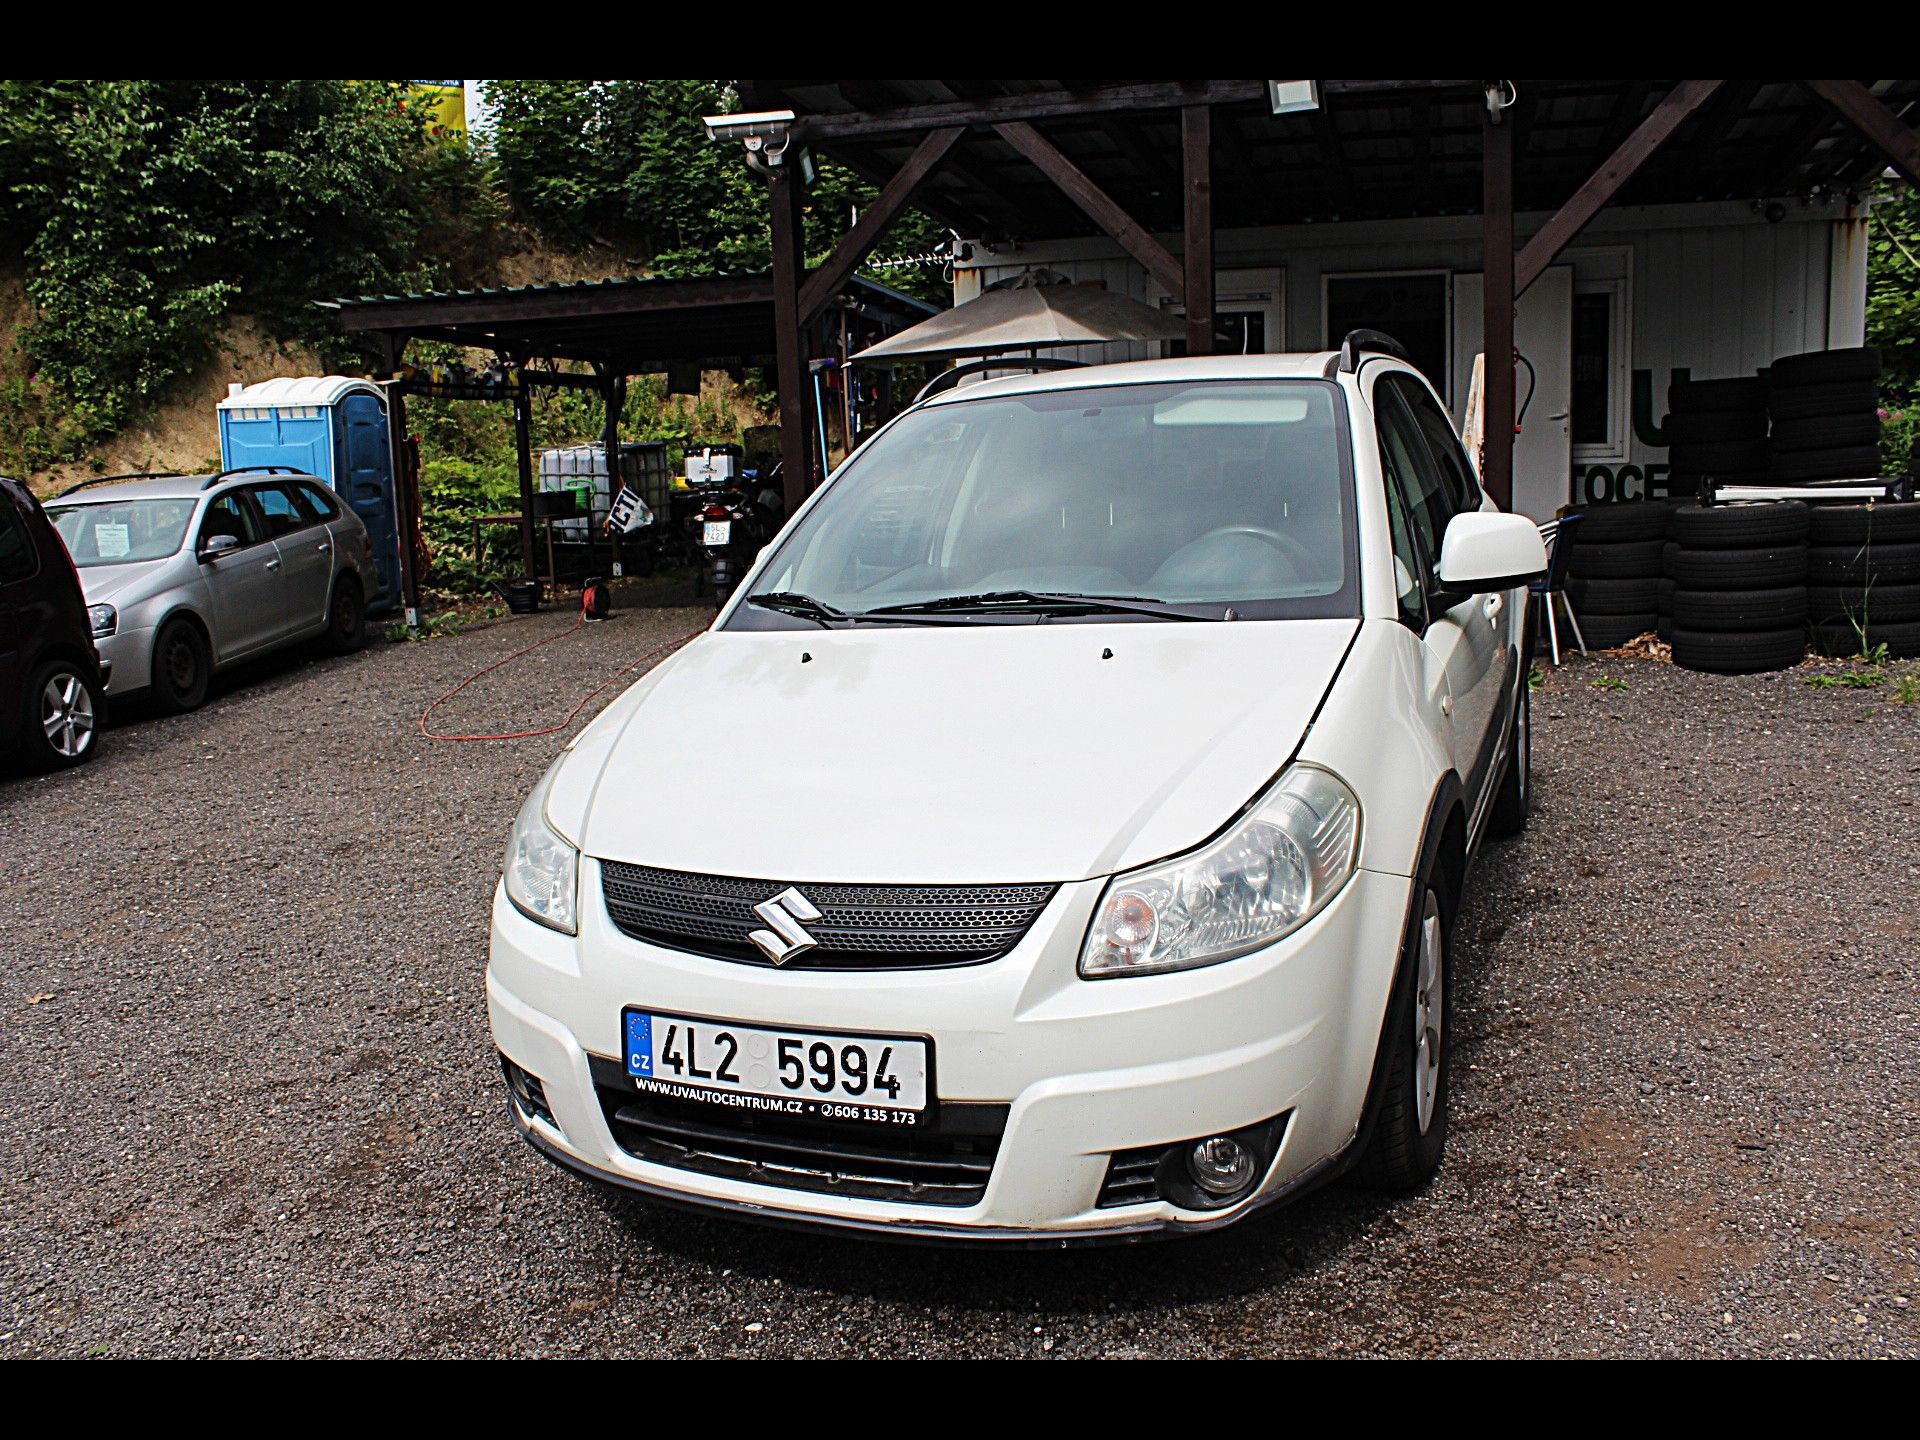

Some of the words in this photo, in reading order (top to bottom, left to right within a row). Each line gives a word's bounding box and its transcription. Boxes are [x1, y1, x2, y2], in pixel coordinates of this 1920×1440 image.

[631, 1053, 650, 1070] CZ
[661, 1024, 740, 1083] 4L2
[777, 1038, 901, 1099] 5994
[635, 1077, 803, 1114] WWW.UVAUTOCENTRUM.CZ
[834, 1106, 859, 1119] 606
[863, 1108, 887, 1122] 135
[892, 1110, 916, 1124] 173
